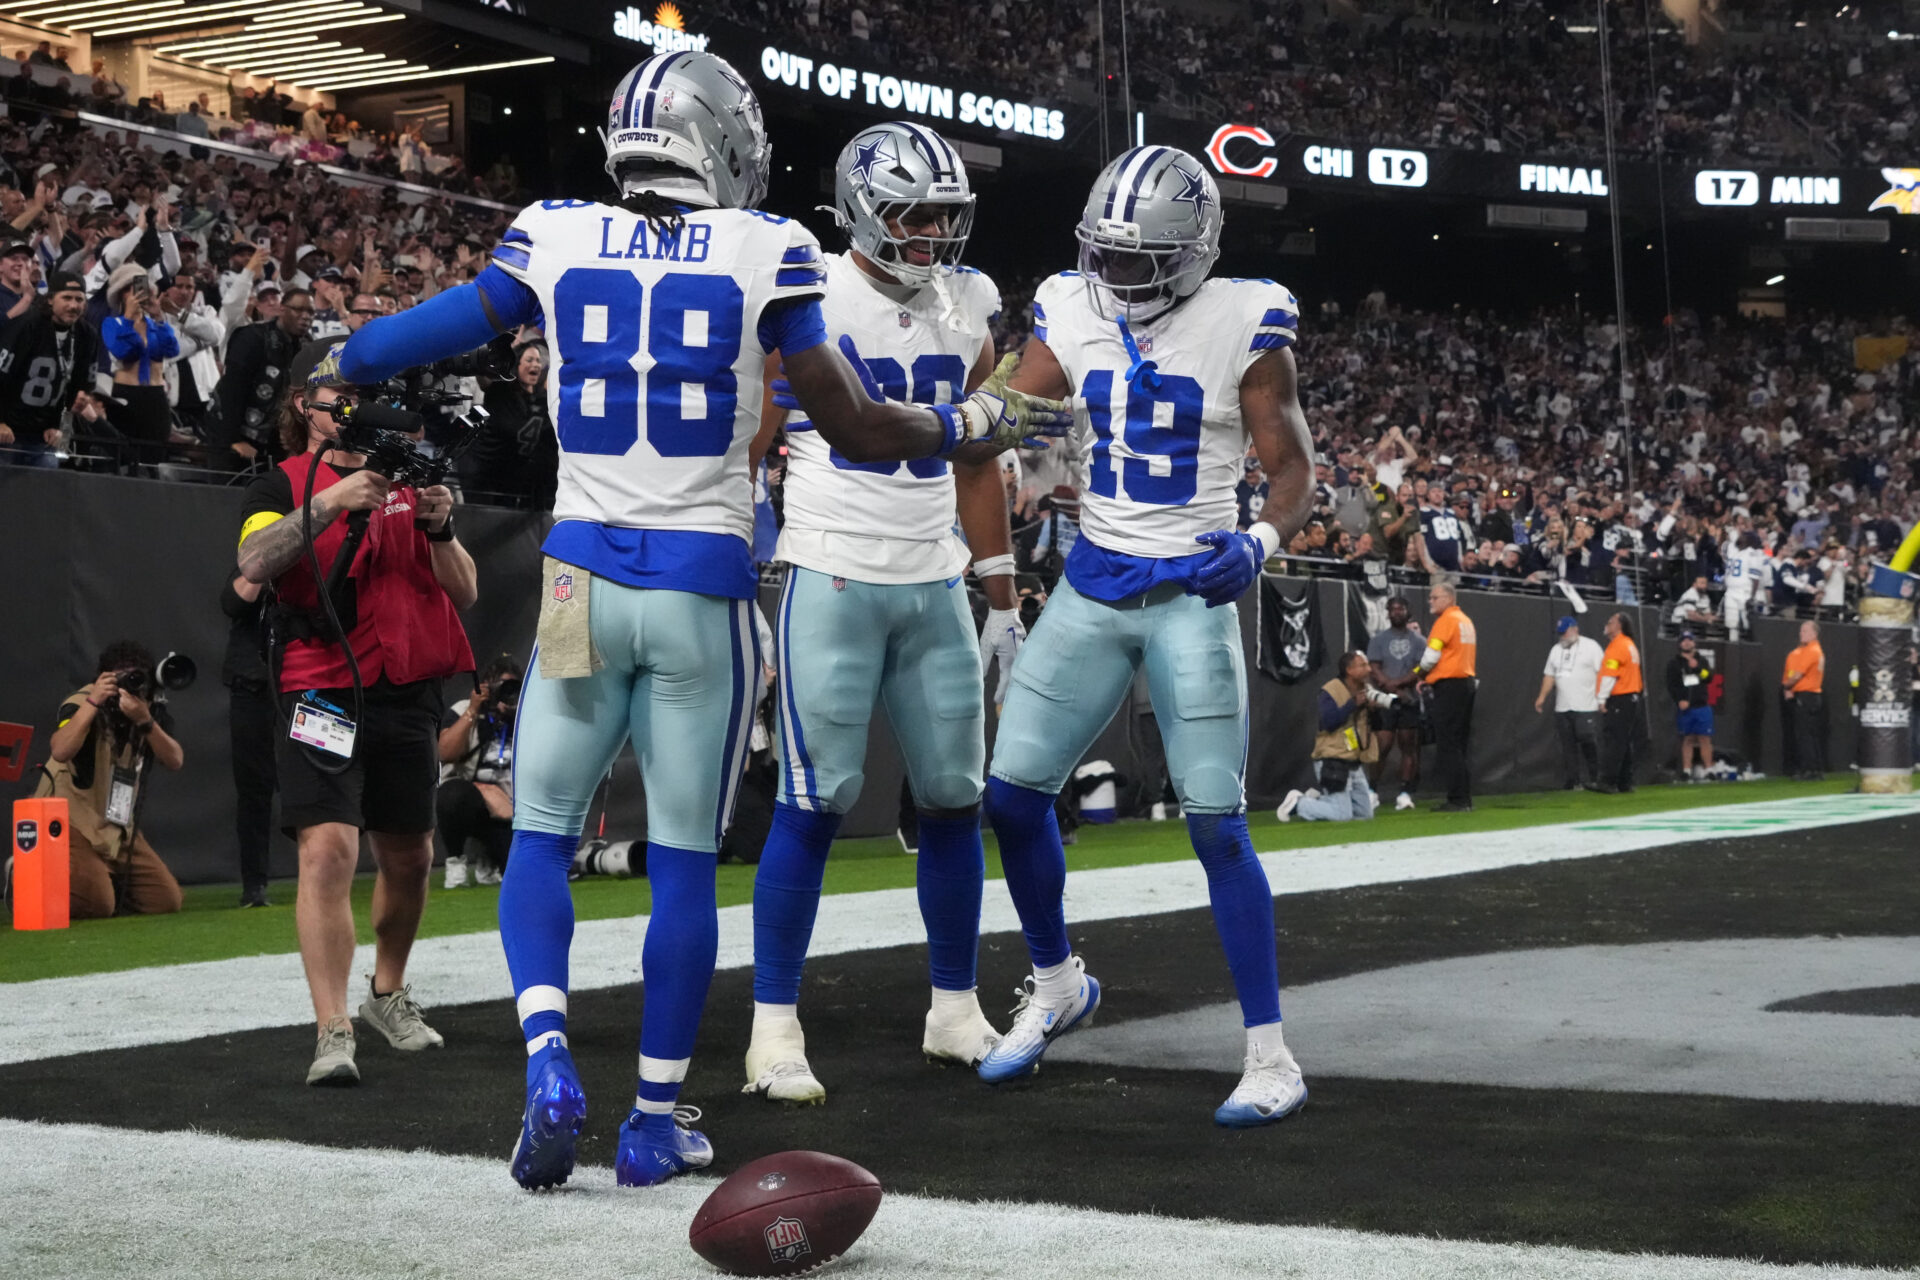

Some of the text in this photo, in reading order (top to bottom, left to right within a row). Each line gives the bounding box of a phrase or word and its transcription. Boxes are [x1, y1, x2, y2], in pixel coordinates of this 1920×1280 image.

[613, 6, 708, 55] allegiant
[761, 46, 1065, 140] OUT OF TOWN SCORES
[617, 131, 659, 144] COWBOYS
[1303, 145, 1841, 205] CHI 19 FINAL 17 MIN
[598, 216, 712, 263] LAMB
[1138, 341, 1152, 353] NFL
[554, 267, 744, 458] 88
[517, 416, 544, 447] 4
[951, 411, 965, 441] 88
[1080, 369, 1205, 505] 19
[1432, 515, 1461, 541] 88
[555, 585, 571, 599] NFL
[1860, 709, 1910, 723] SERVICE
[768, 1223, 803, 1248] NFL
